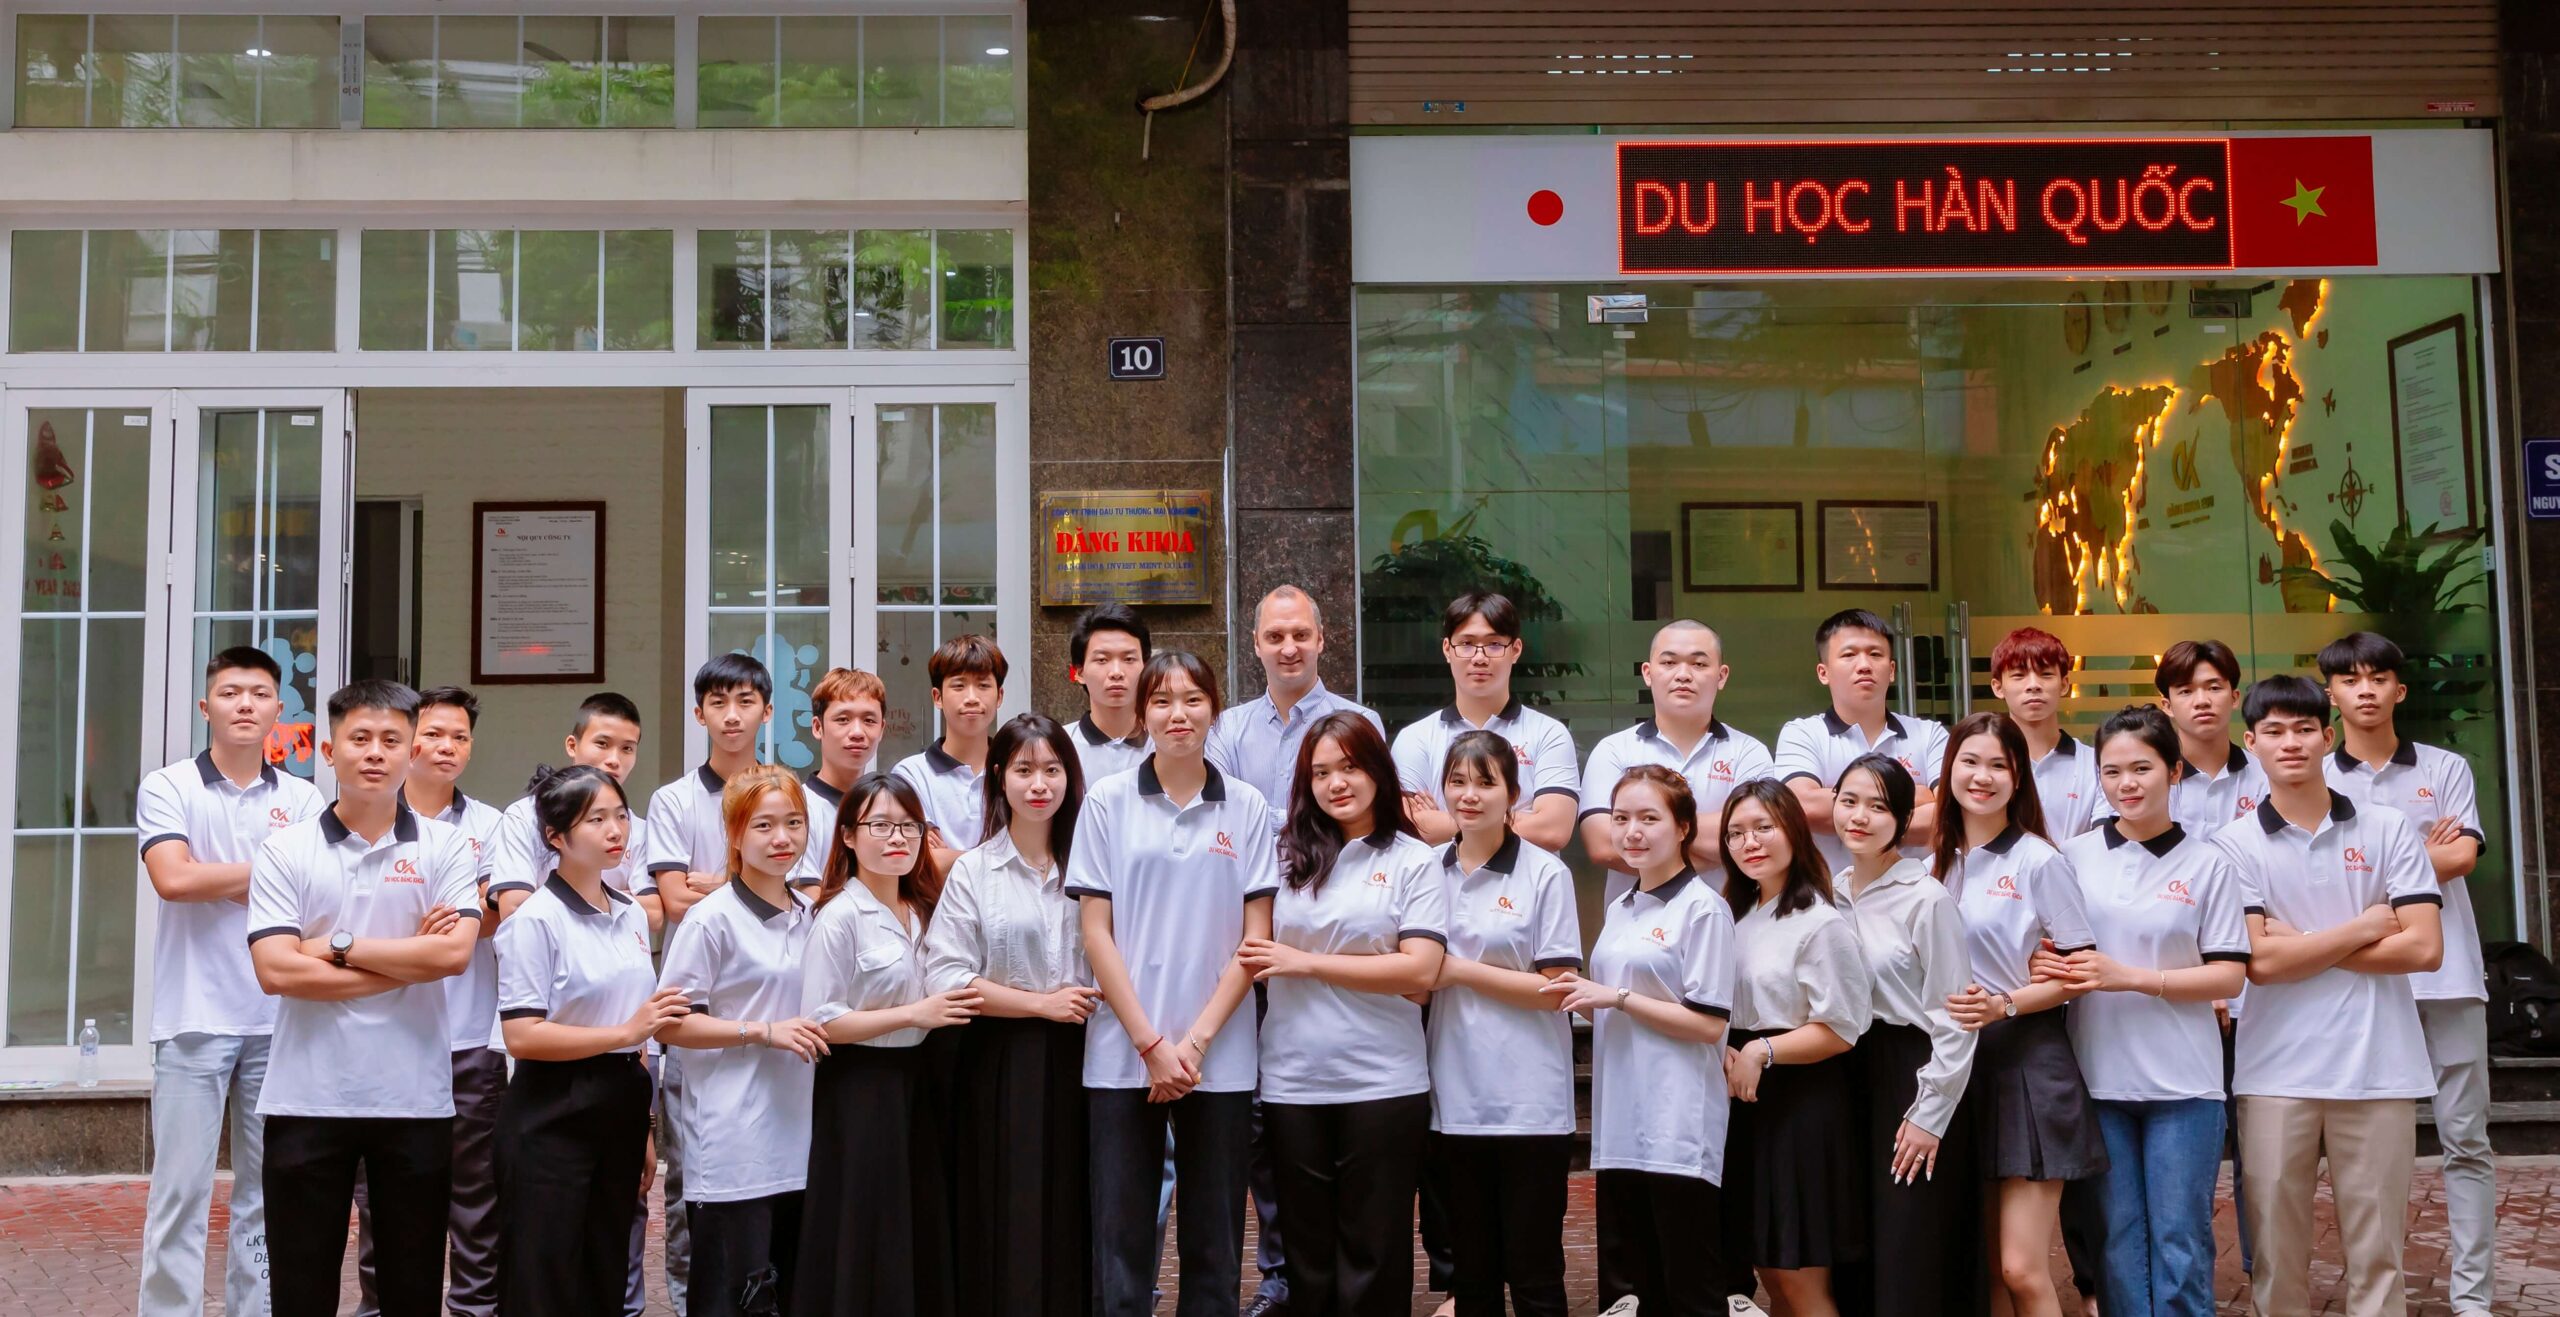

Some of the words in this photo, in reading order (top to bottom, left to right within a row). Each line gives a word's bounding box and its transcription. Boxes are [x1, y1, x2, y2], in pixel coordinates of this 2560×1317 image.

[1635, 180, 1716, 234] DU
[1744, 179, 1872, 244] HỌC
[1896, 164, 2015, 232] HÀN
[2042, 164, 2214, 244] QUỐC
[1121, 345, 1153, 370] 10
[1056, 527, 1120, 554] ĐĂNG
[1127, 530, 1195, 553] KHOA
